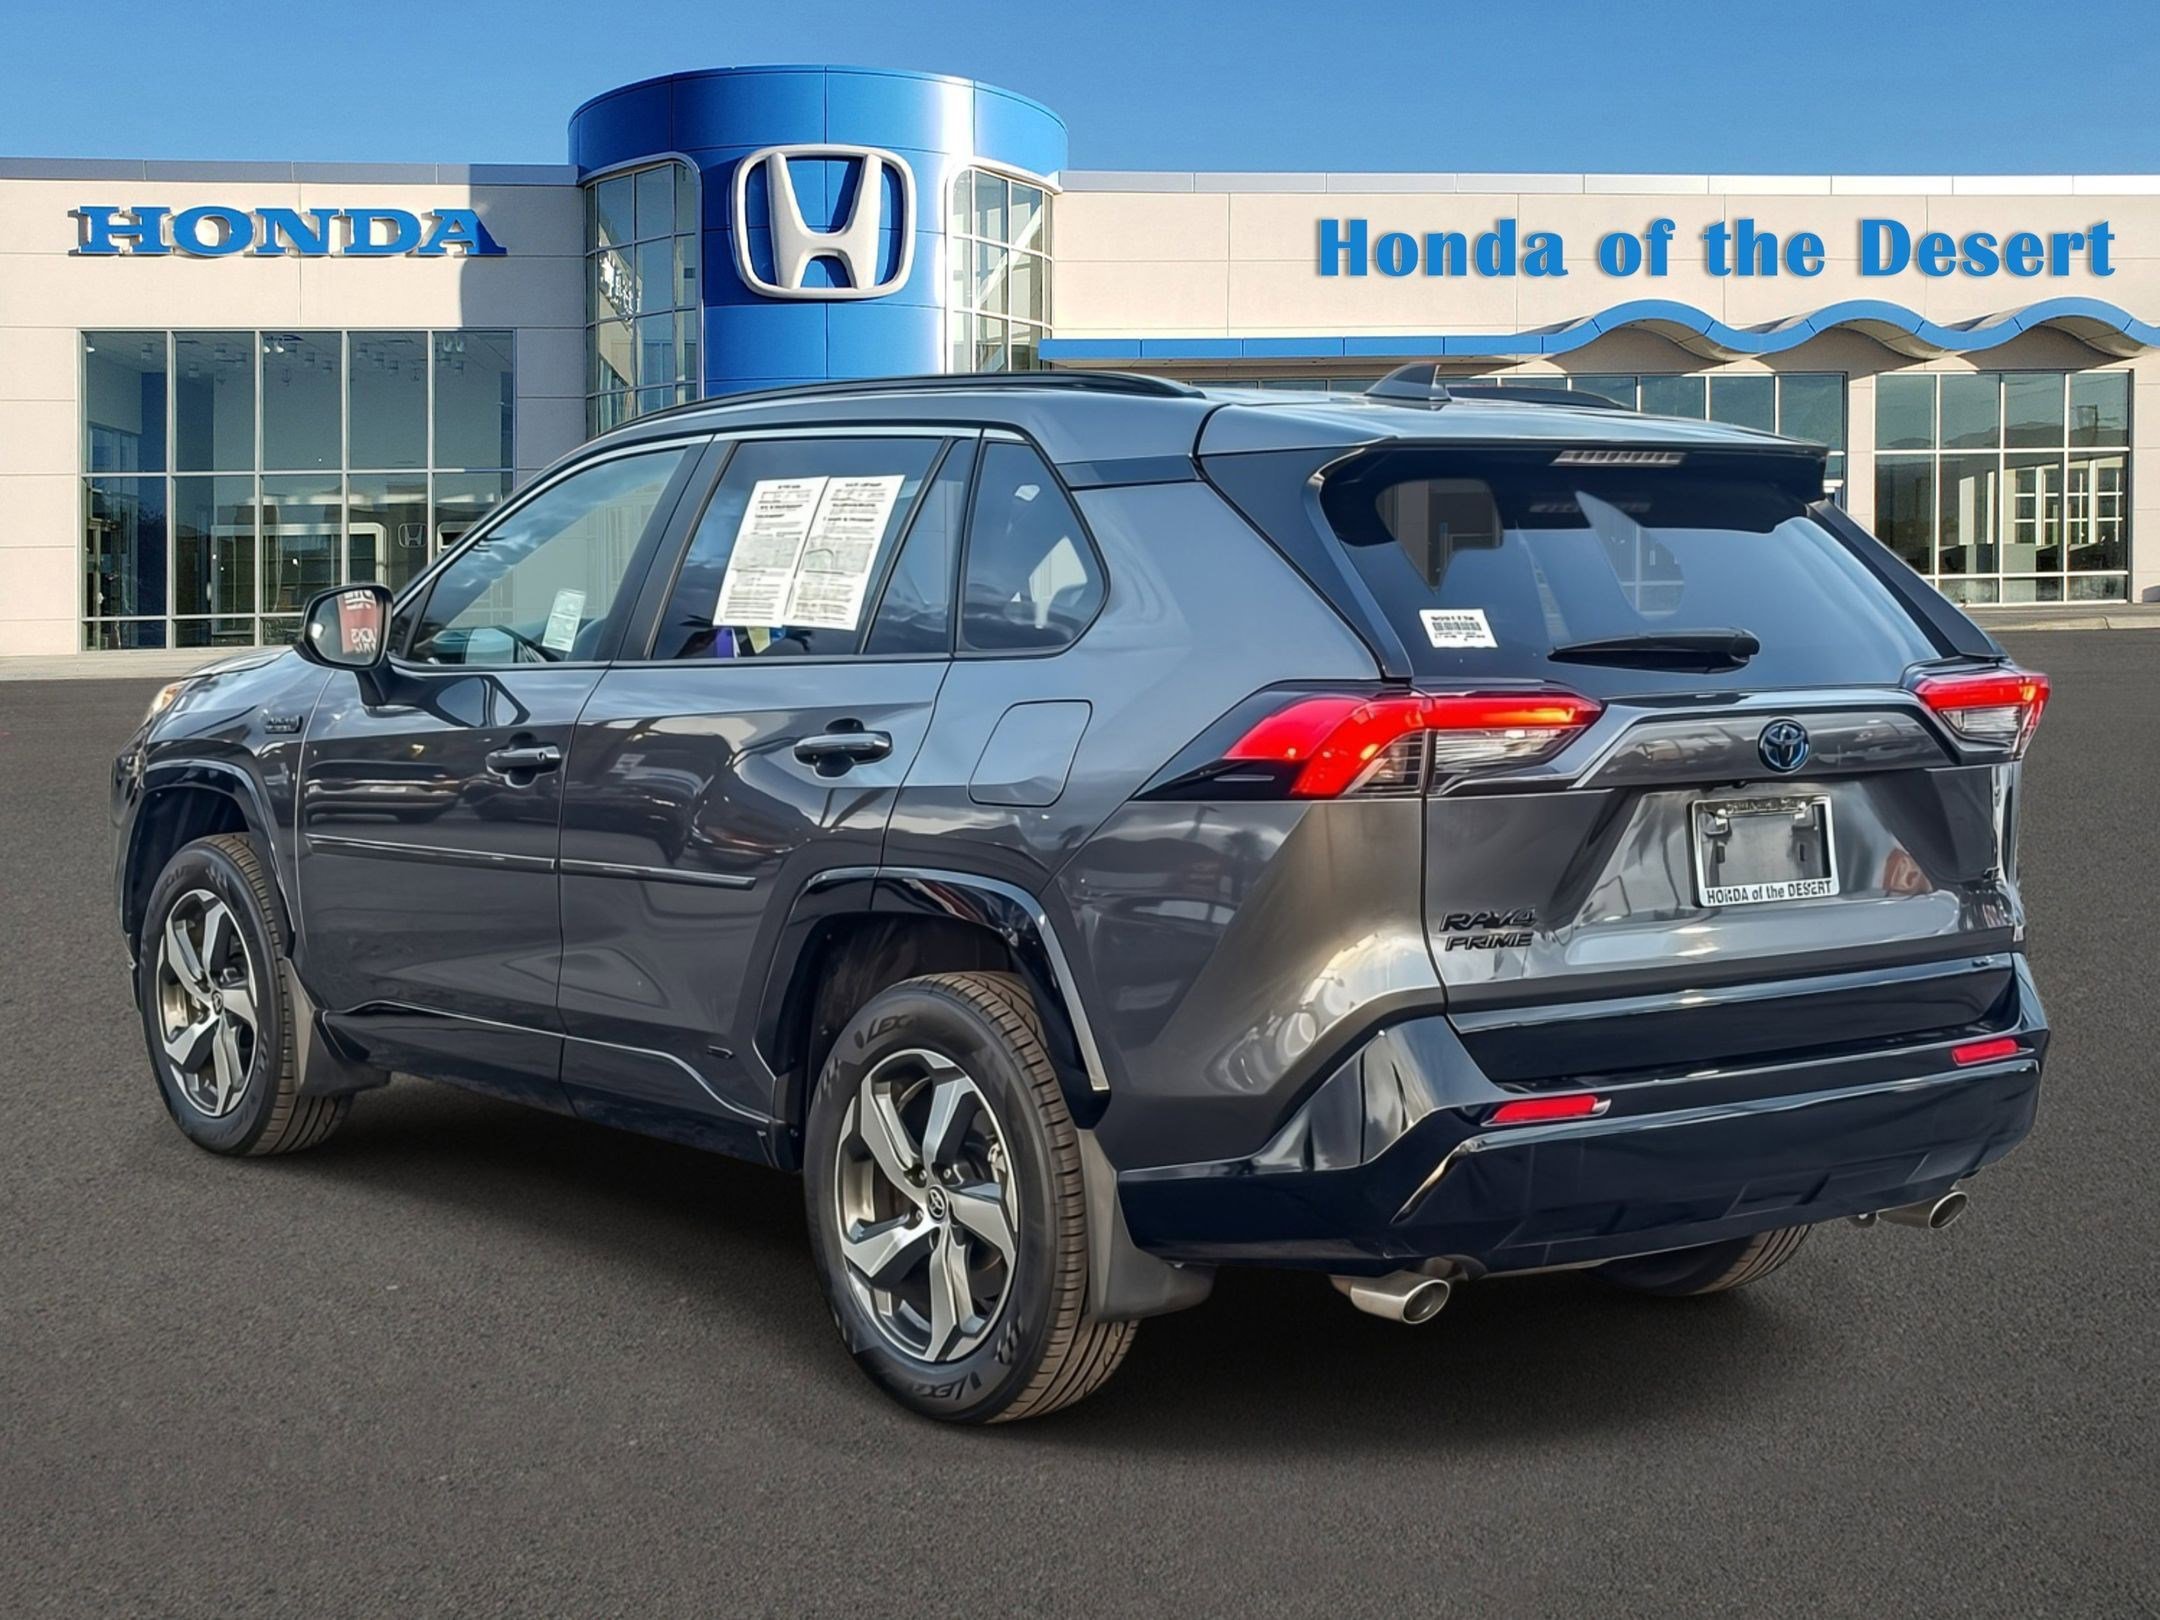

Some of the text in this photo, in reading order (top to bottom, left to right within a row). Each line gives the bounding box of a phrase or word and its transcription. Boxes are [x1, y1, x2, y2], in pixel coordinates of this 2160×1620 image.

[71, 206, 508, 258] HONDA
[1319, 218, 2116, 277] Honda of the Desert
[1706, 879, 1832, 904] HONDA of the DESERT
[1440, 908, 1537, 932] RAV4
[1445, 932, 1534, 951] PRIME
